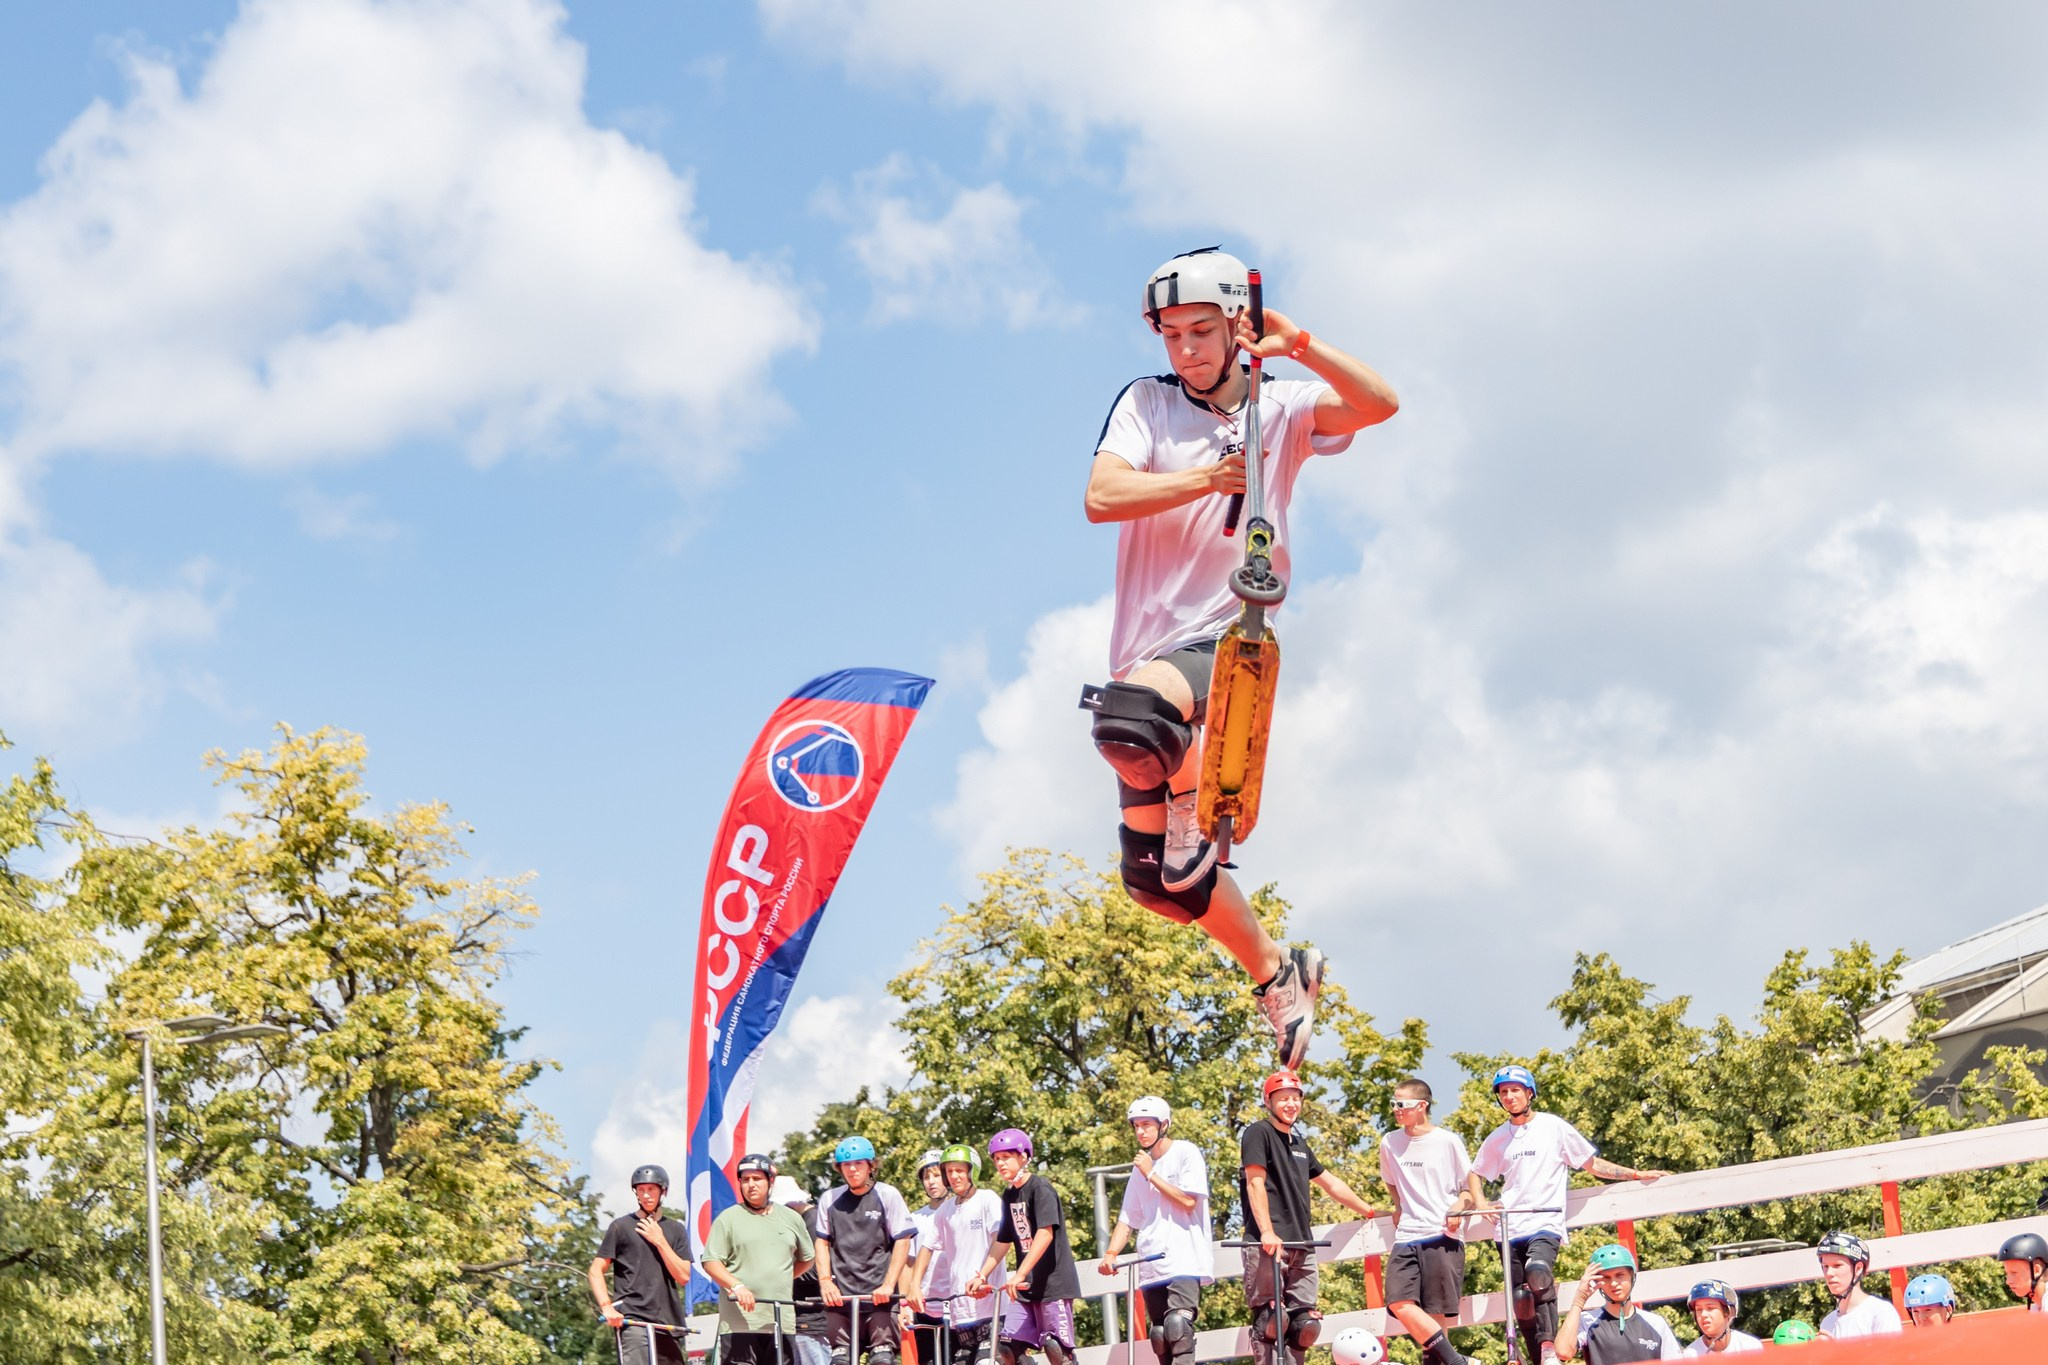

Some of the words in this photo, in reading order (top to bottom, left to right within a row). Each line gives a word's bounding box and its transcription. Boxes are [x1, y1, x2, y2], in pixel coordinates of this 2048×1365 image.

[721, 1005, 742, 1067] ФЕДЕРАЦИЯ
[737, 936, 769, 1005] САМОКАТНОГО
[763, 898, 786, 936] СПОРТА
[780, 857, 804, 898] РОССИИ
